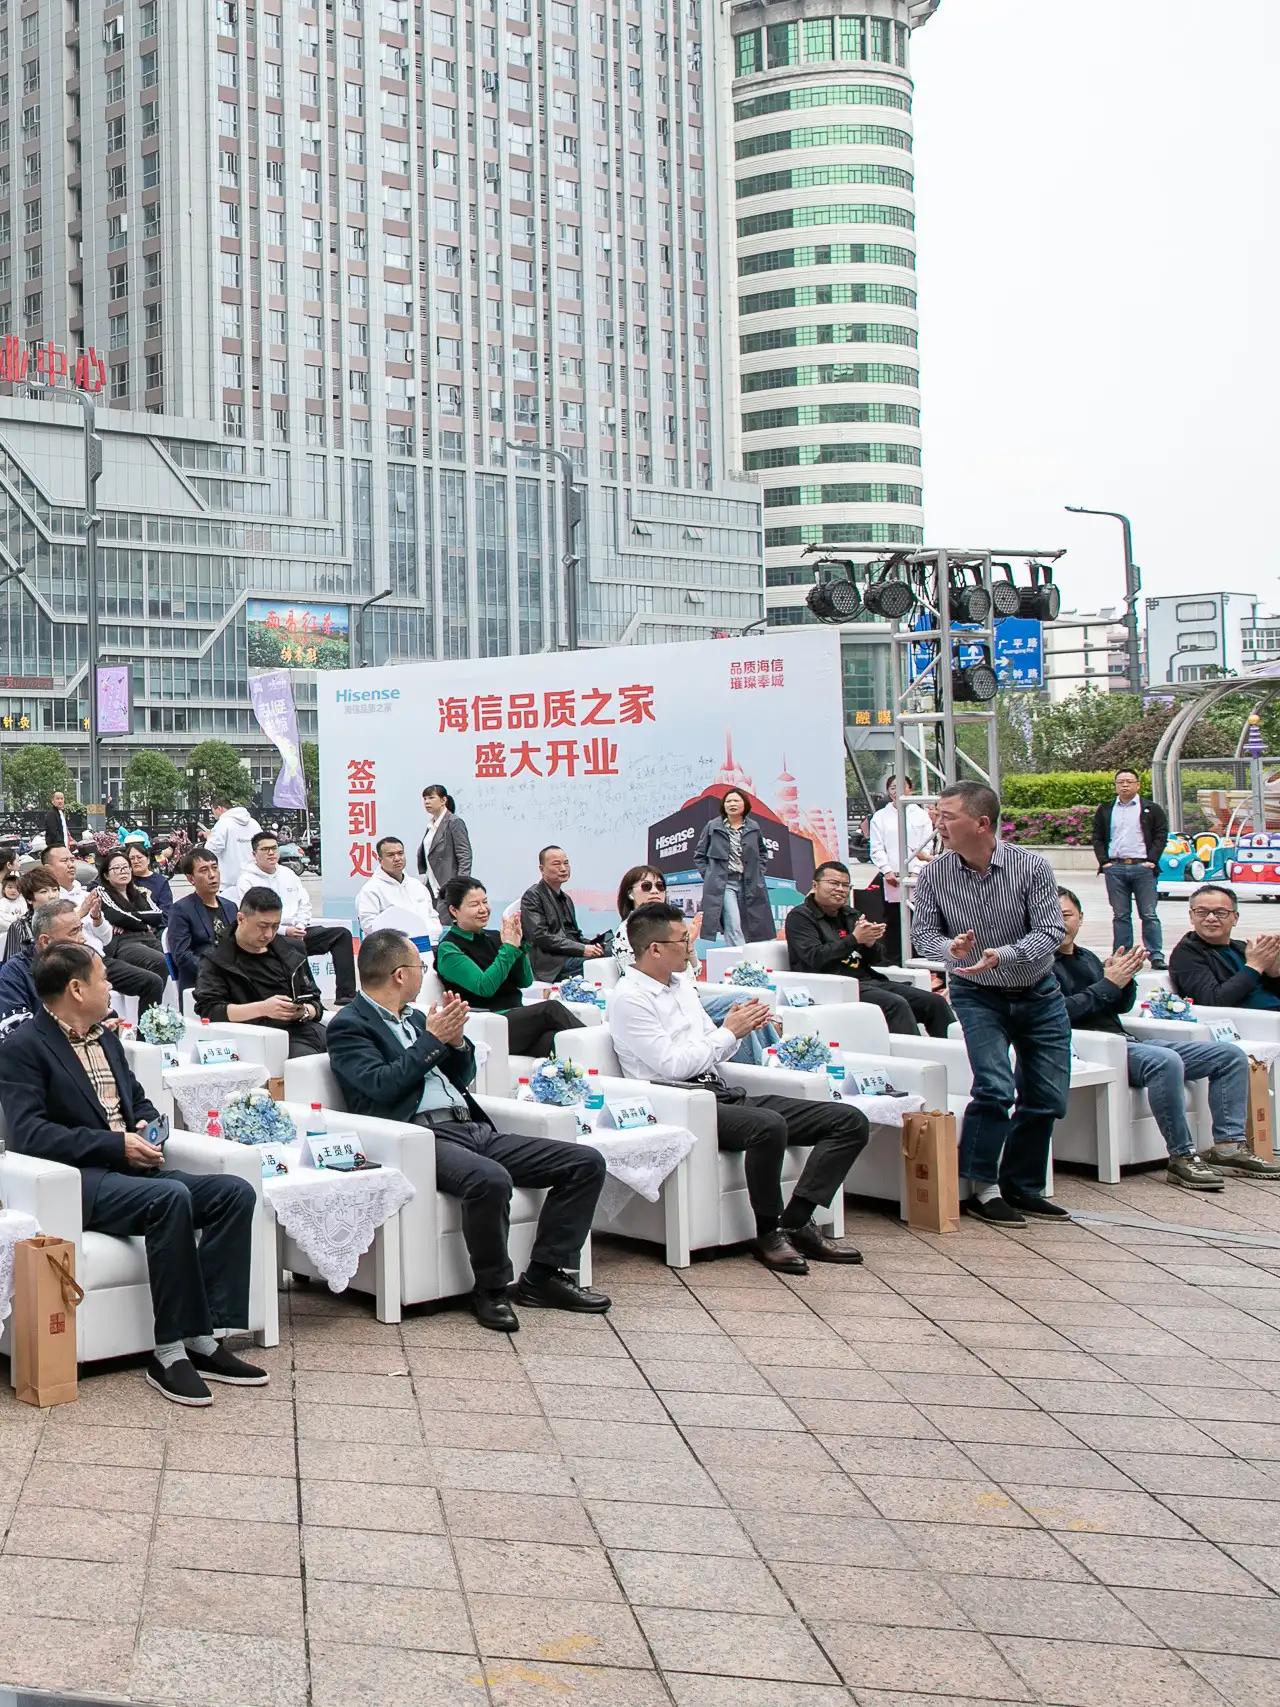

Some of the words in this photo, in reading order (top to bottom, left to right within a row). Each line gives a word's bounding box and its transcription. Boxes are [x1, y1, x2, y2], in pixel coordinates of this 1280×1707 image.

[730, 658, 784, 675] 品质海信
[336, 688, 400, 703] Hisense
[437, 684, 657, 733] 海信品质之家
[474, 737, 619, 778] 盛大开业
[347, 759, 380, 877] 签到处
[655, 827, 695, 850] Hisense
